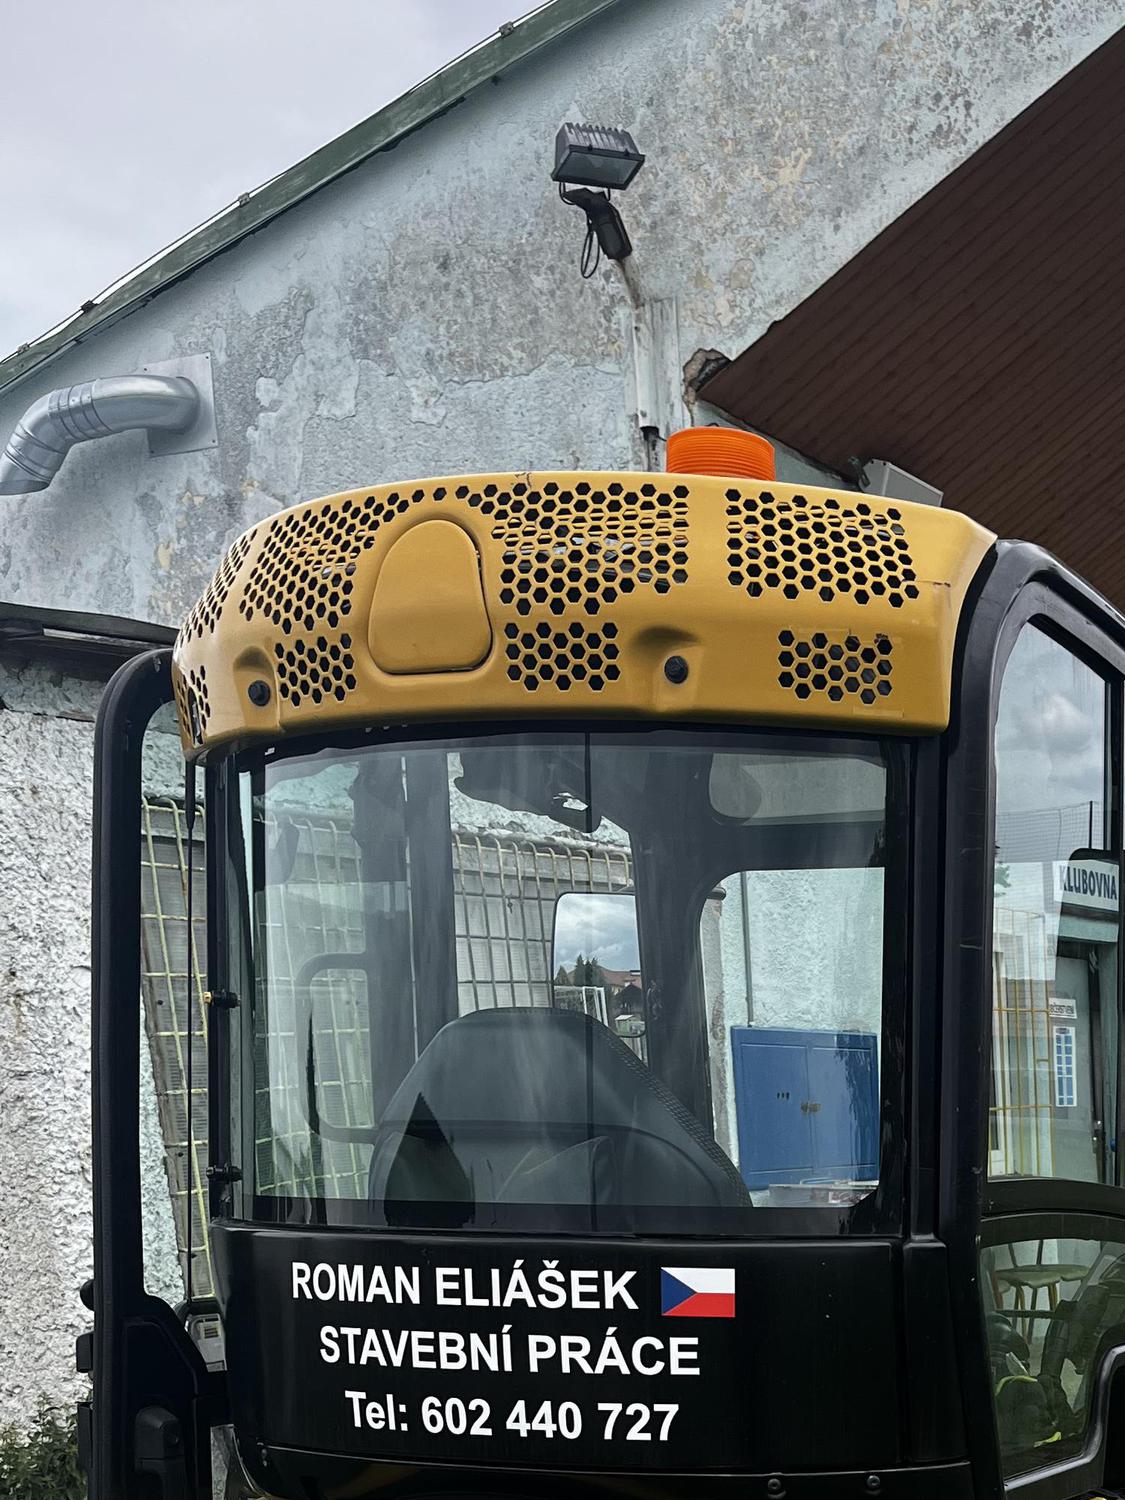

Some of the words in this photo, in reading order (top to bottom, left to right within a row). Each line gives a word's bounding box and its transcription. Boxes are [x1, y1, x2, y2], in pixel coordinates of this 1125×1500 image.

[1060, 866, 1118, 900] KLUBOVNA
[291, 1262, 421, 1305] ROMAN
[435, 1259, 639, 1310] ELIÁŠEK
[319, 1325, 514, 1373] STAVEBNÍ
[528, 1326, 701, 1376] PRÁCE
[345, 1390, 408, 1432] Tel:
[421, 1396, 493, 1436] 602
[505, 1400, 583, 1439] 440
[598, 1402, 680, 1442] 727
